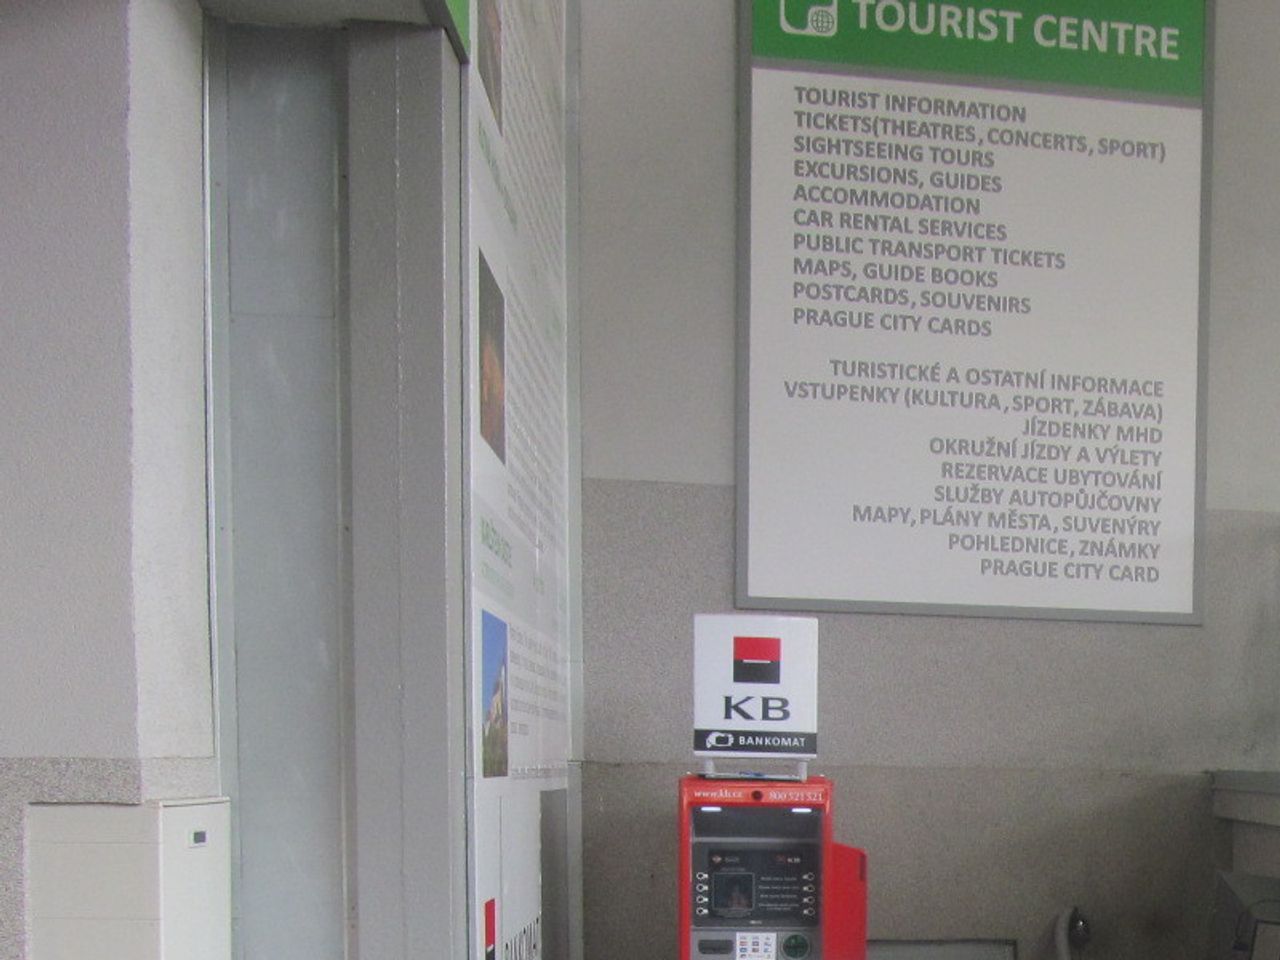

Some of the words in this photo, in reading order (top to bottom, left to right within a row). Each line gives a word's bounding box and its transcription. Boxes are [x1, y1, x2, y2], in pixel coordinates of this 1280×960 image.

[852, 0, 1021, 44] TOURIST
[1033, 16, 1180, 61] CENTRE
[794, 86, 880, 110] TOURIST
[886, 93, 1026, 123] INFORMATION
[793, 135, 923, 163] SIGHTSEEING
[929, 145, 995, 168] TOURS
[987, 127, 1094, 157] CONCERTS,
[1099, 136, 1167, 164] SPORT)
[794, 159, 925, 190] EXCURSIONS,
[929, 170, 1002, 193] GUIDES
[793, 185, 981, 215] ACCOMMODATION
[794, 209, 833, 229] CAR
[839, 212, 913, 236] RENTAL
[917, 217, 1007, 241] SERVICES
[794, 233, 863, 256] PUBLIC
[868, 238, 986, 264] TRANSPORT
[991, 247, 1066, 270] TICKETS
[793, 257, 857, 281] MAPS,
[863, 262, 926, 284] GUIDE
[931, 267, 998, 289] BOOKS
[793, 282, 917, 309] POSTCARDS,
[920, 289, 1032, 315] SOUVENIRS
[793, 308, 875, 331] PRAGUE
[880, 313, 922, 333] CITY
[927, 316, 992, 338] CARDS
[830, 359, 942, 385] TURISTICKÉ
[946, 367, 960, 385] A
[966, 367, 1046, 390] OSTATNÍ
[1051, 373, 1164, 398] INFORMACE
[784, 380, 900, 406] VSTUPENKY
[1012, 394, 1079, 419] SPORT,
[1082, 395, 1163, 423] ZÁBAVA)
[1022, 417, 1111, 442] JÍZDENKY
[1116, 425, 1162, 445] MHD
[929, 435, 1017, 460] OKRUŽNÍ
[1020, 440, 1072, 464] JÍZDY
[1076, 446, 1091, 464] A
[1095, 444, 1162, 468] VÝLETY
[941, 461, 1048, 485] REZERVACE
[1053, 467, 1162, 491] UBYTOVÁNÍ
[934, 483, 1004, 506] SLUŽBY
[1009, 487, 1162, 514] AUTOPŮJČOVNY
[852, 504, 916, 527] MAPY,
[920, 507, 982, 529] PLÁNY
[987, 510, 1059, 534] MĚSTA,
[1062, 513, 1161, 538] SUVENÝRY
[948, 533, 1075, 558] POHLEDNICE,
[1078, 536, 1161, 561] ZNÁMKY
[980, 558, 1058, 580] PRAGUE
[1063, 563, 1104, 581] CITY
[1108, 565, 1160, 584] CARD
[723, 695, 791, 721] KB
[738, 735, 806, 748] BANKOMAT
